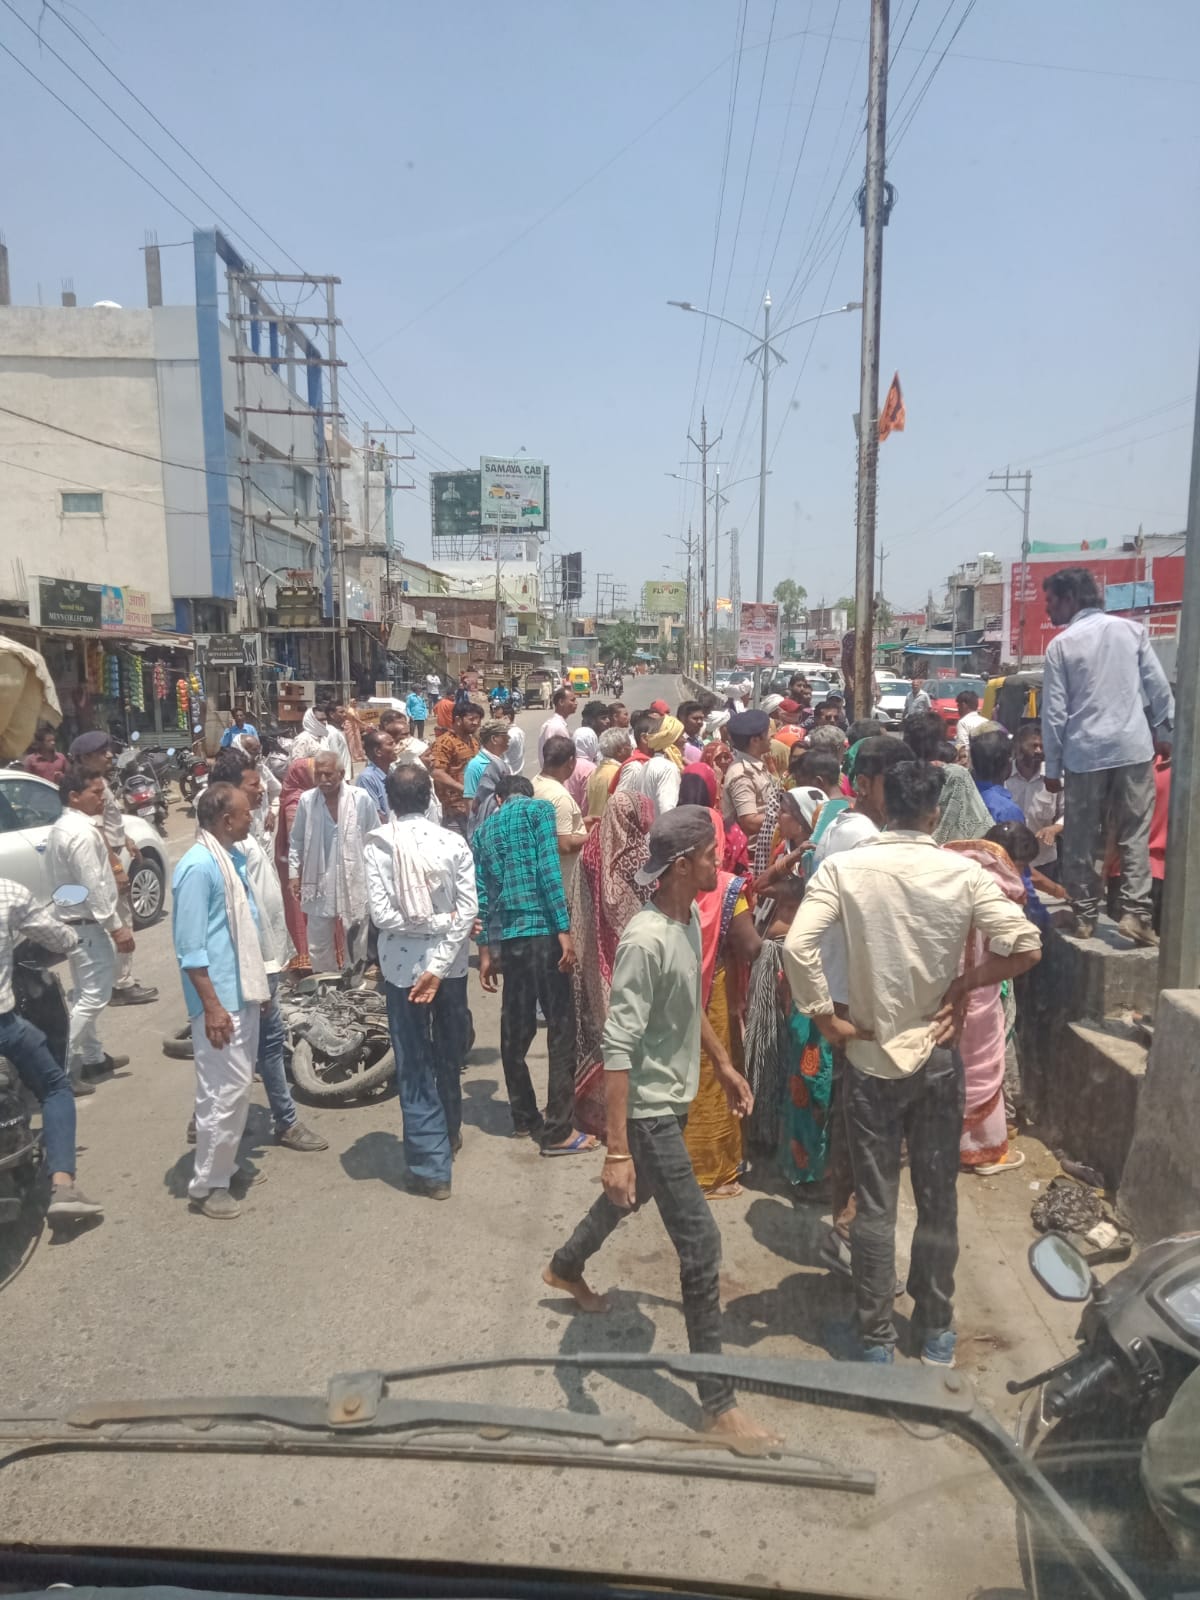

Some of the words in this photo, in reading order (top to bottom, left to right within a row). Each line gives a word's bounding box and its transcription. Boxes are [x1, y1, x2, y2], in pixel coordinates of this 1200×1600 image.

[485, 463, 521, 474] SAMAYA
[524, 465, 542, 475] CAB
[64, 614, 93, 623] COLLECTION
